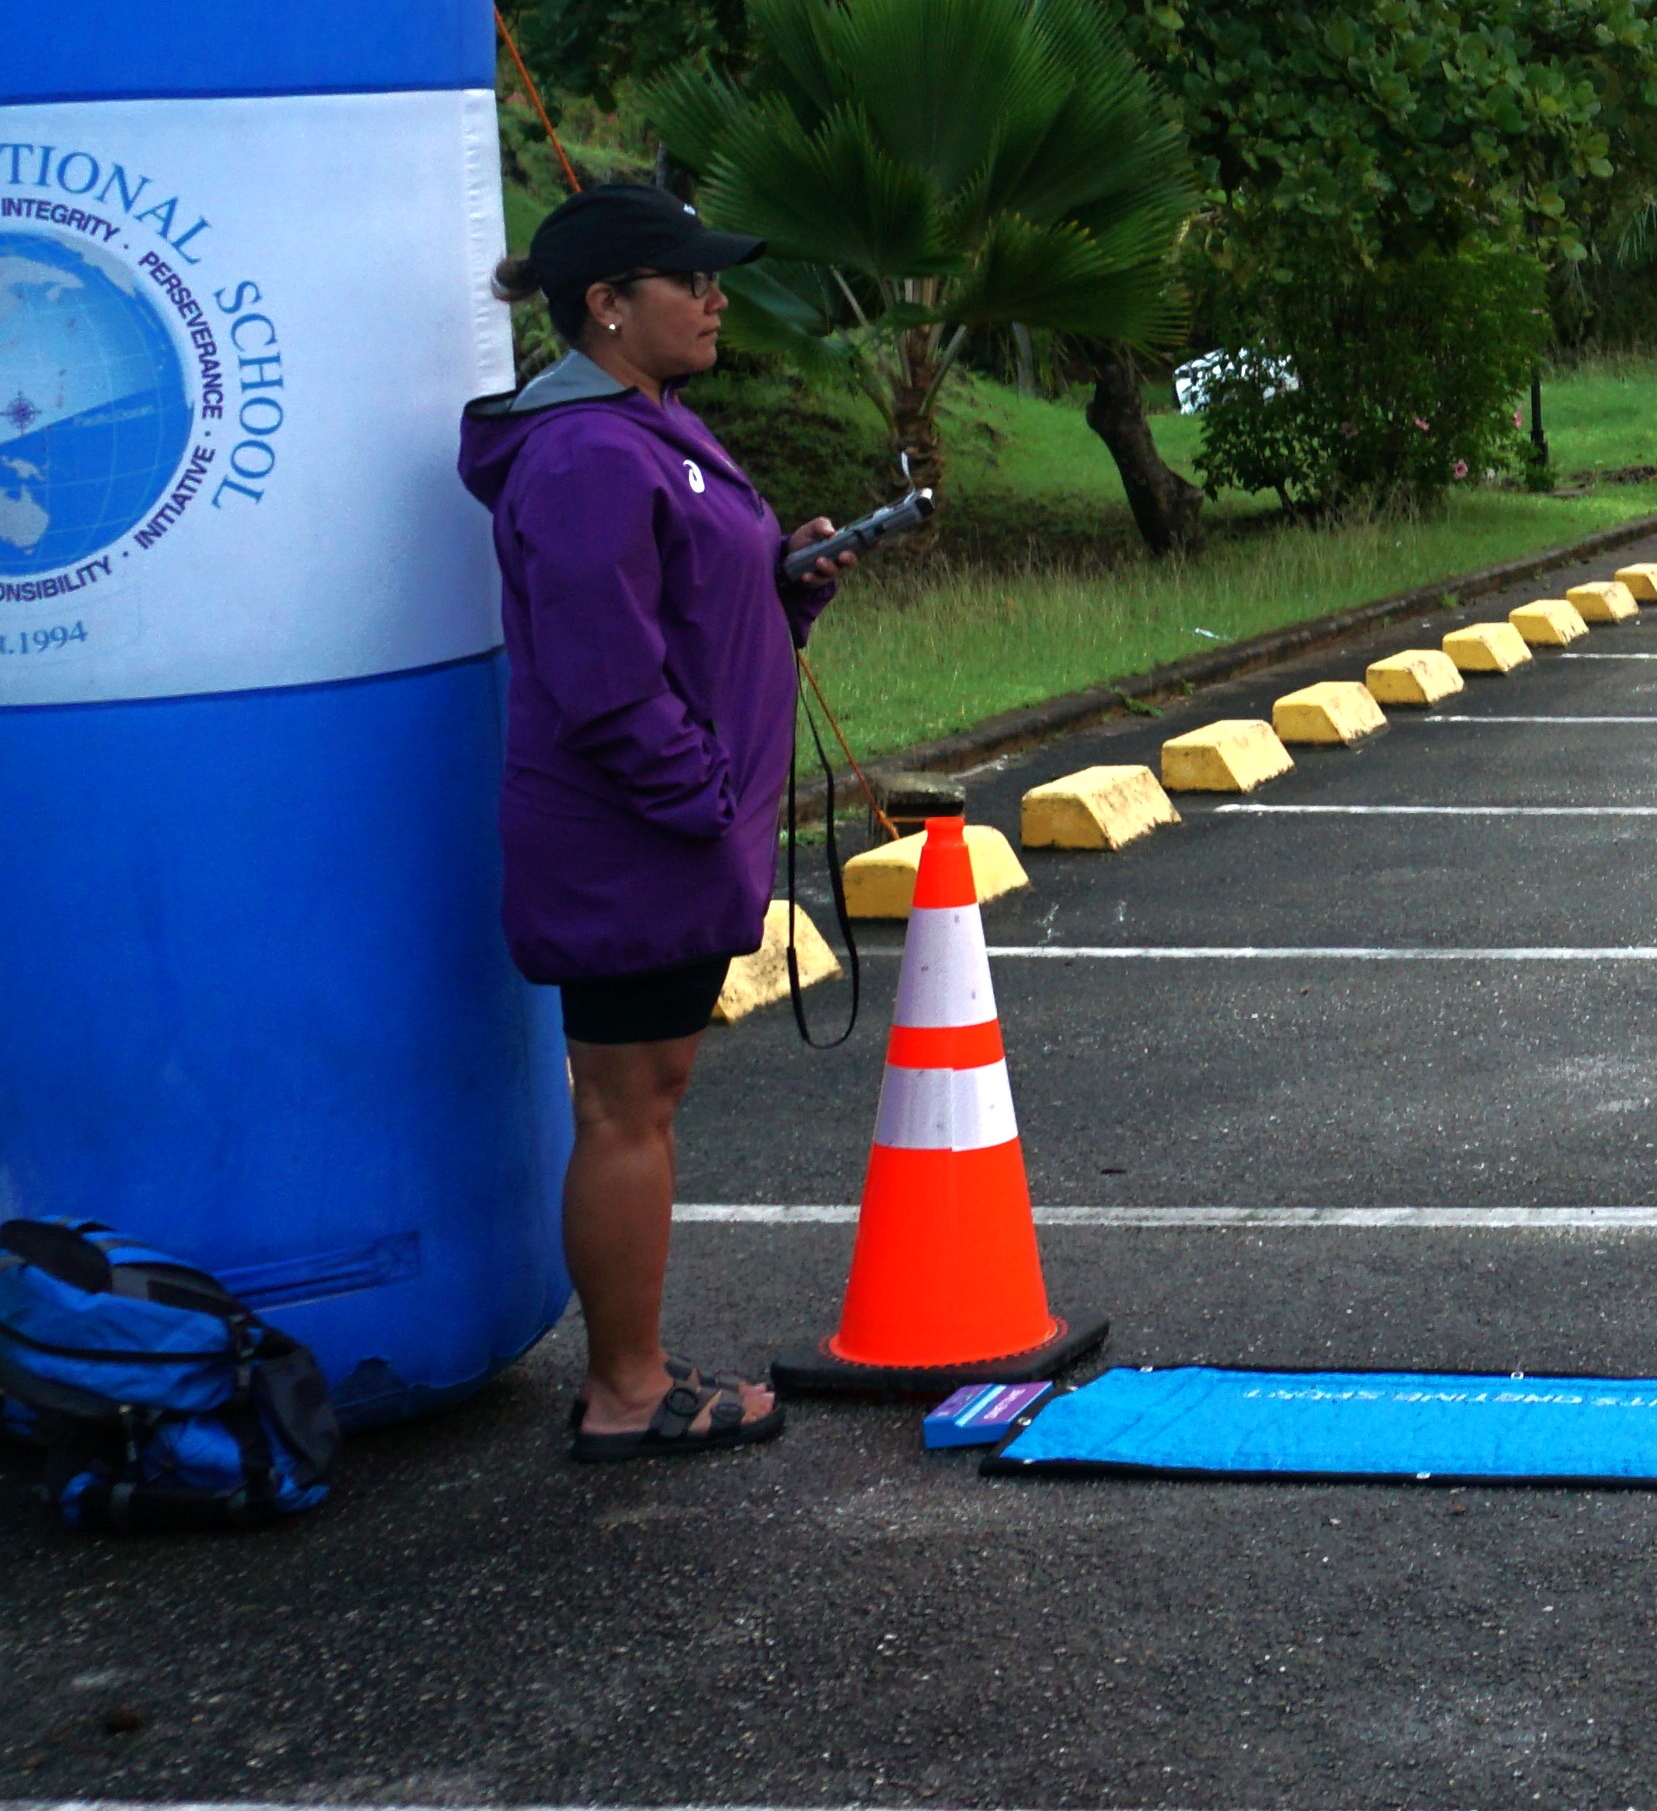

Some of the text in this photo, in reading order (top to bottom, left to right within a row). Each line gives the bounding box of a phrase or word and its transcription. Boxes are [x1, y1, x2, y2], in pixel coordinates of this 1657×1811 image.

[0, 197, 121, 242] INTEGRITY
[137, 250, 225, 421] PERSEVERANCE
[212, 279, 285, 511] SCHOOL
[132, 445, 217, 550] INITIATIVE
